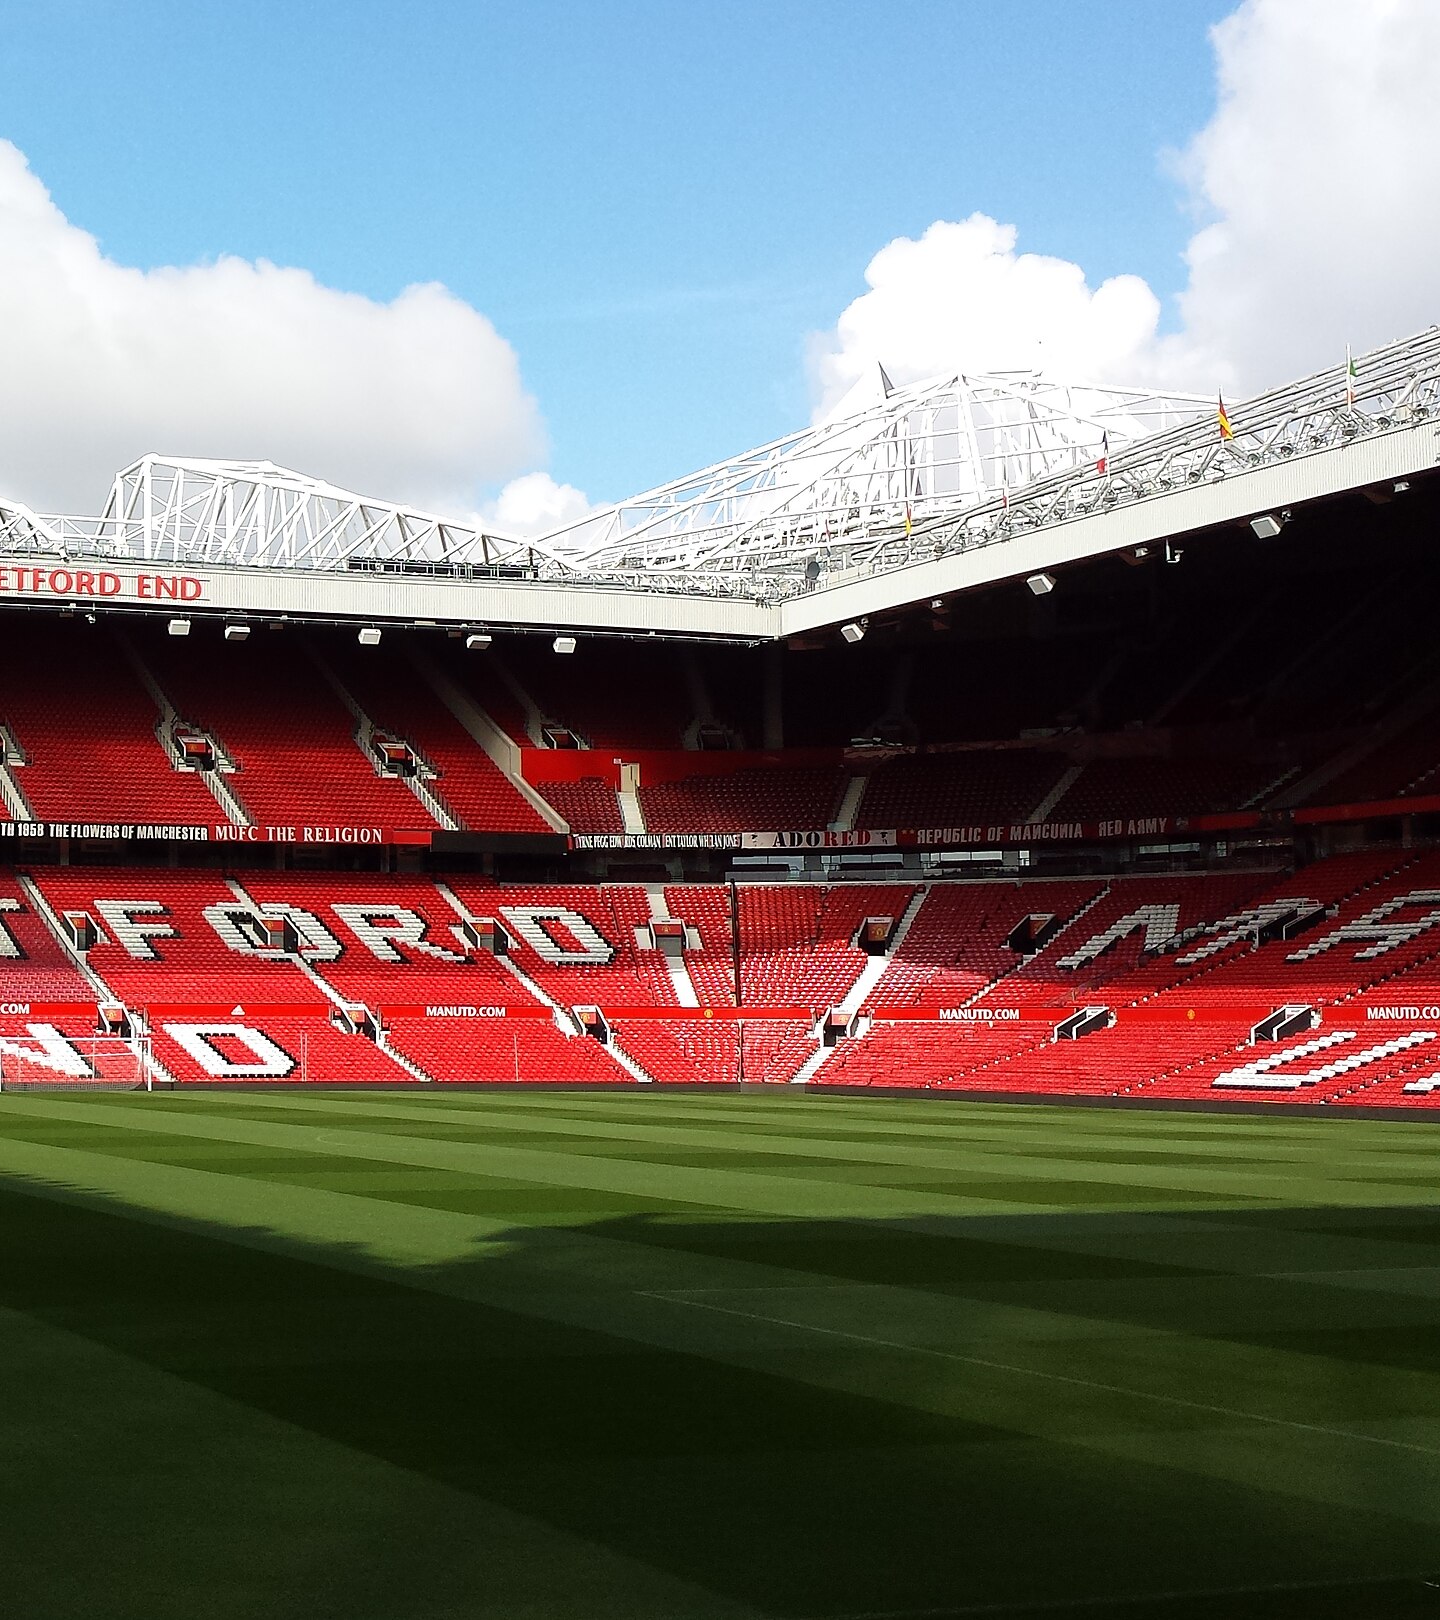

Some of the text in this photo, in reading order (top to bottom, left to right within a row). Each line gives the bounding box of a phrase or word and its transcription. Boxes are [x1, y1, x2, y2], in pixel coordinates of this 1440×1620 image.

[137, 574, 202, 601] END
[17, 822, 44, 837] 1958
[49, 822, 70, 838] THE
[71, 823, 120, 839] FLOWERS
[121, 825, 135, 840] OF
[136, 825, 208, 841] MANCHESTER
[215, 825, 383, 844] MUFC THE RELIGION
[772, 831, 872, 848] ADORED
[987, 826, 1004, 843] OF
[425, 1005, 506, 1017] MANUTD.COM
[939, 1008, 1020, 1021] MANUTD.COM
